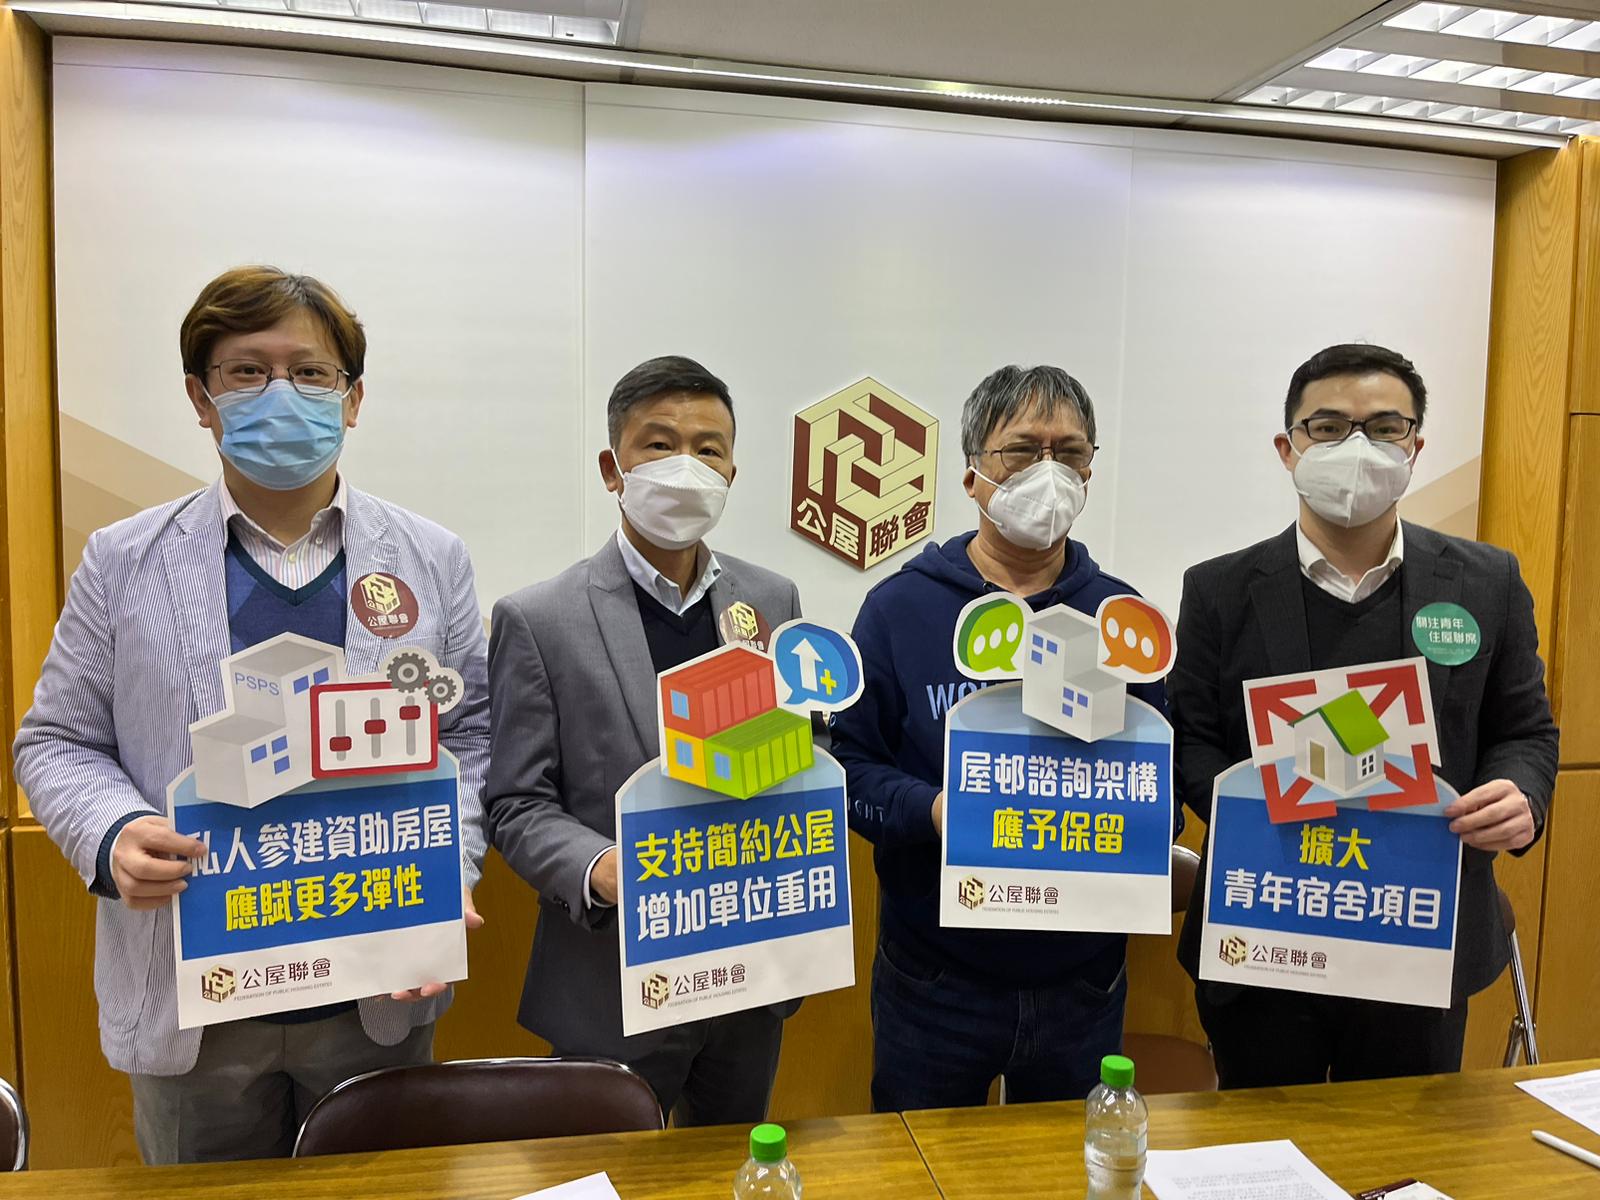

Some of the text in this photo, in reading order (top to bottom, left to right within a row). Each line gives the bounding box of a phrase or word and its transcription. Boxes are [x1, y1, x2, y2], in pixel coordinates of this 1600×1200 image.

[235, 672, 280, 696] PSPS
[959, 751, 1158, 803] 屋邨諮詢架構
[635, 809, 835, 882] 支持簡約公屋
[992, 808, 1125, 854] 應予保留
[1299, 824, 1371, 871] 擴大
[225, 863, 424, 932] 應賦更多彈性
[636, 864, 837, 942] 增加單位重用
[989, 884, 1059, 905] 公屋聯會
[1224, 868, 1441, 930] 青年宿舍項目
[242, 958, 331, 989] 公屋聯會
[674, 963, 746, 996] 公屋聯會
[1252, 944, 1327, 969] 公屋聯會
